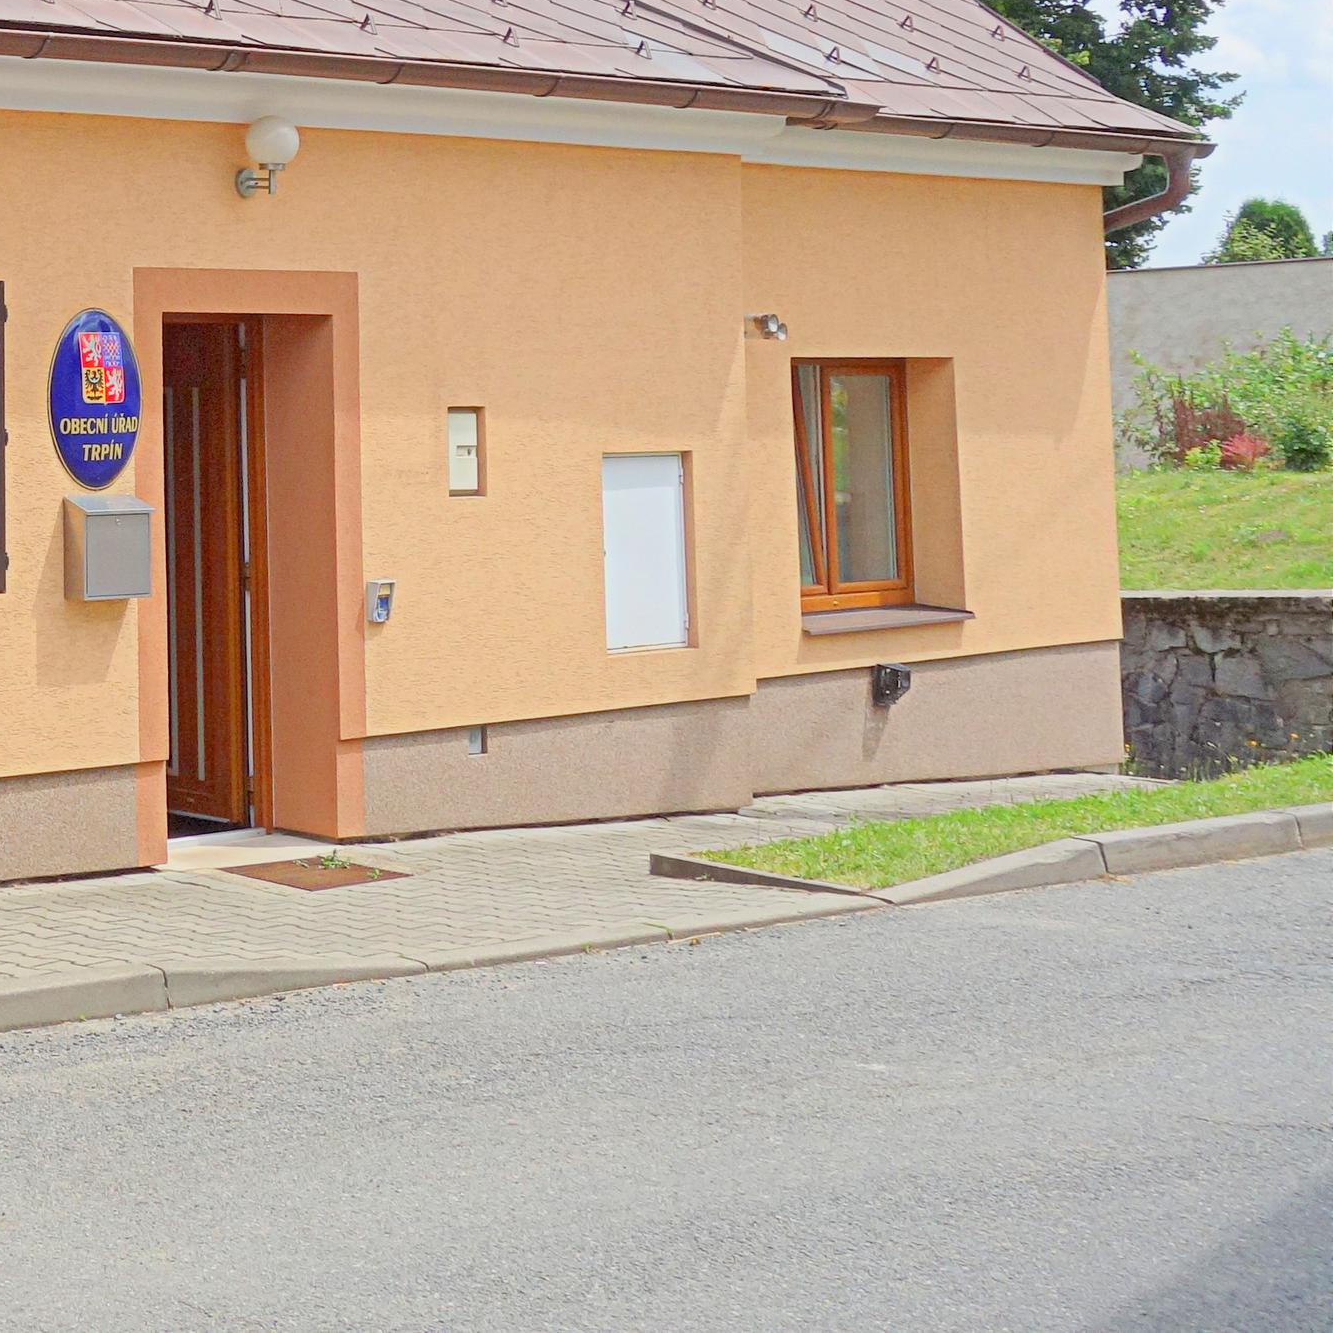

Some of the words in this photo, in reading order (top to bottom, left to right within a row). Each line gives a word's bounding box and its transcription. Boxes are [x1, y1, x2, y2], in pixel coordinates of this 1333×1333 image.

[59, 413, 108, 435] OBECNÍ
[111, 412, 138, 433] ÚŘAD
[82, 439, 123, 461] TRPÍN
